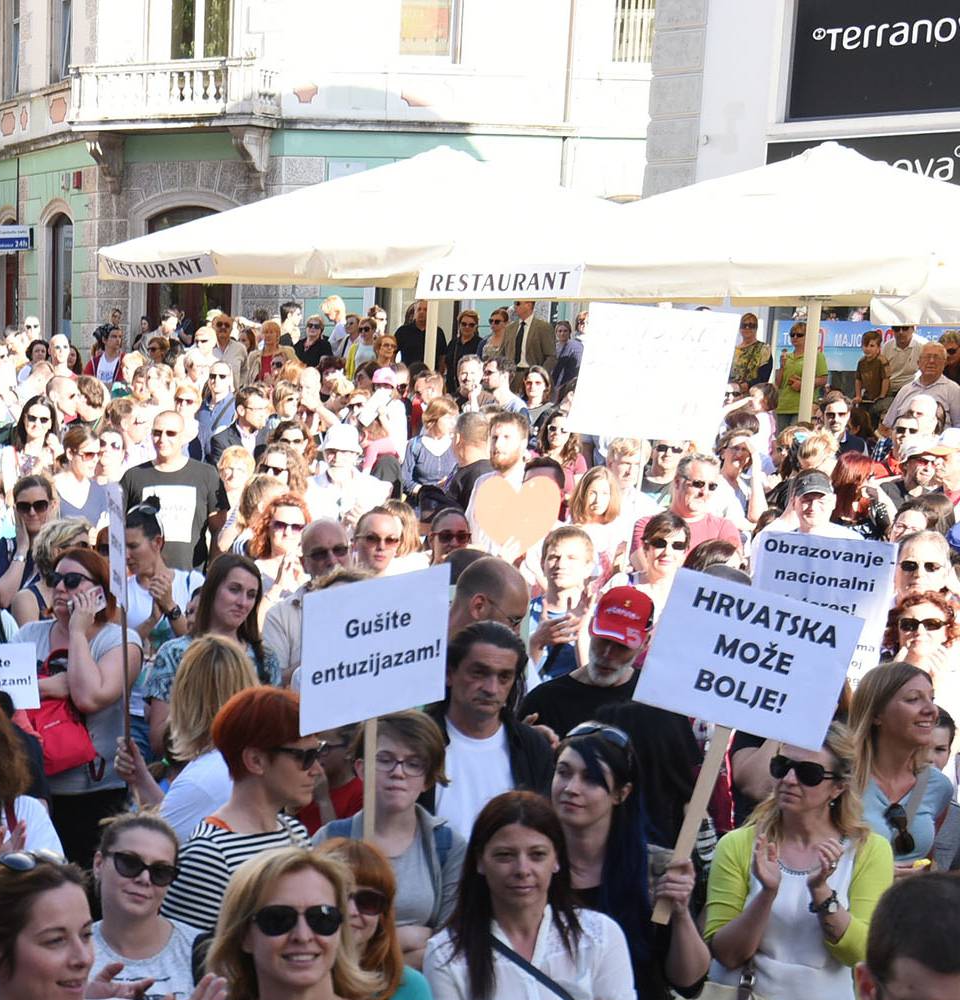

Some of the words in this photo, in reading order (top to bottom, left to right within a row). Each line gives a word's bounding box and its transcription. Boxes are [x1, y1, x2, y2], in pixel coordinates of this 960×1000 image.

[826, 17, 960, 52] Terrano
[105, 256, 203, 279] RESTAURANT
[429, 271, 571, 292] RESTAURANT
[764, 538, 884, 568] Obrazovanje
[774, 568, 876, 593] nacionalni
[345, 609, 412, 639] Gušite
[691, 586, 837, 649] HRVATSKA
[311, 638, 441, 686] entuzijazam!
[713, 633, 794, 676] MOŽE
[693, 668, 788, 714] BOLJE!
